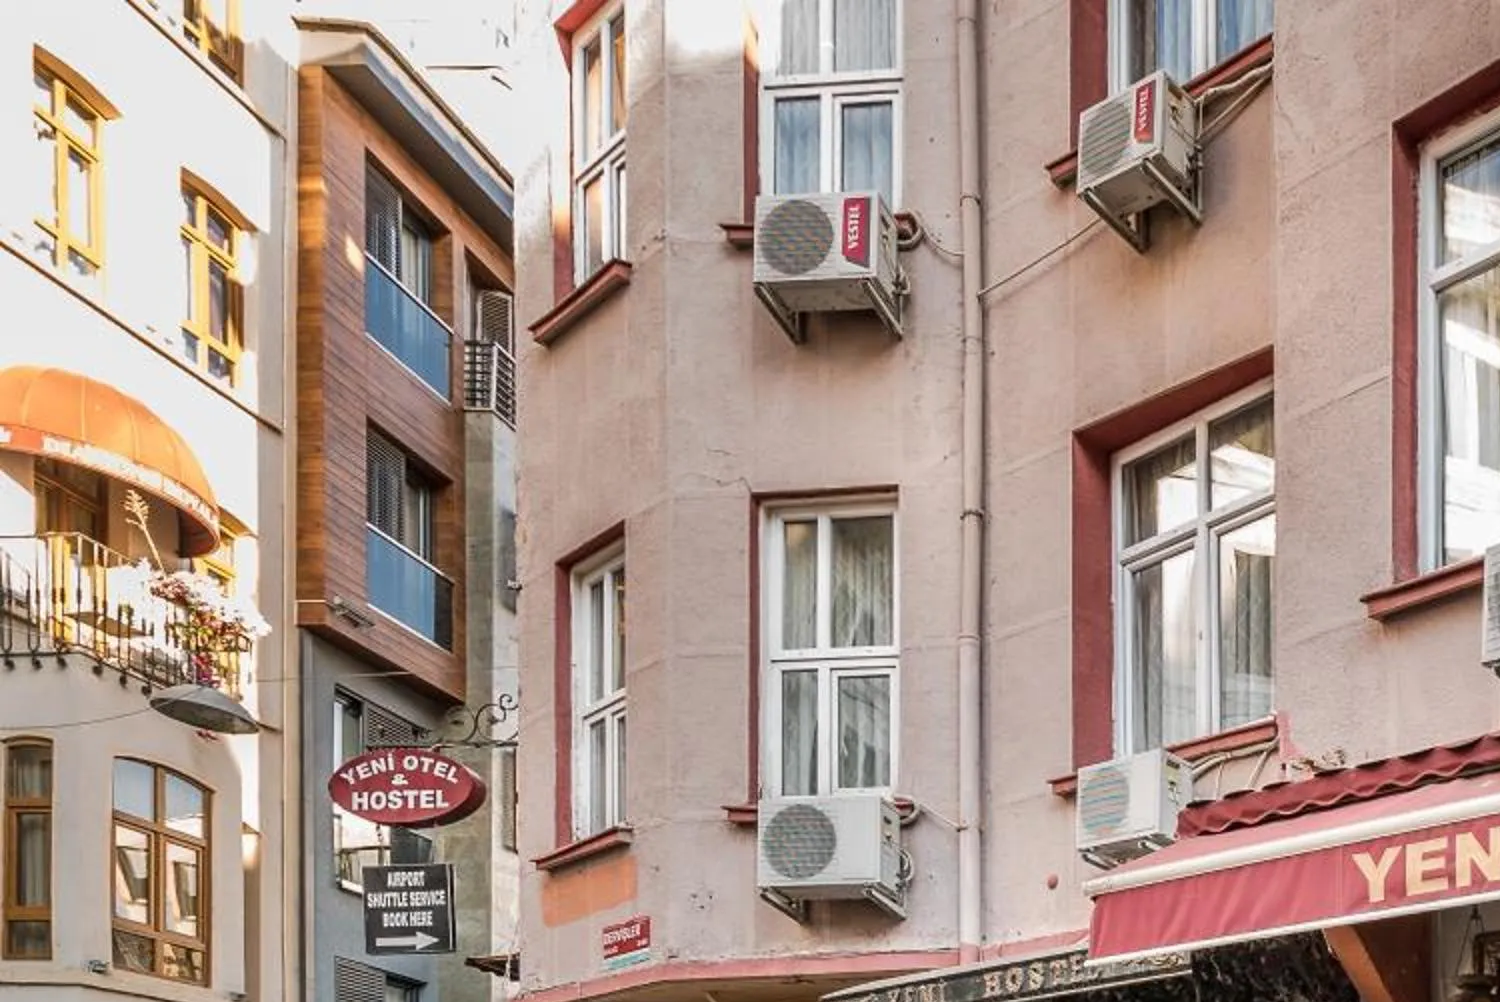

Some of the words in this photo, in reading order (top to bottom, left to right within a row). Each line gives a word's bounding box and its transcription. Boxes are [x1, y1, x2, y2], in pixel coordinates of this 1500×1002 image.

[1138, 84, 1150, 132] VESTEL
[847, 203, 862, 249] VESTEL
[339, 753, 395, 785] YENİ
[402, 755, 459, 784] OTEL
[391, 773, 409, 785] &
[351, 789, 450, 811] HOSTEL
[387, 870, 425, 888] AIRPORT
[367, 890, 409, 909] SHUTTLE
[409, 888, 446, 907] SERVICE
[383, 911, 409, 928] BOOK
[409, 910, 433, 927] HERE
